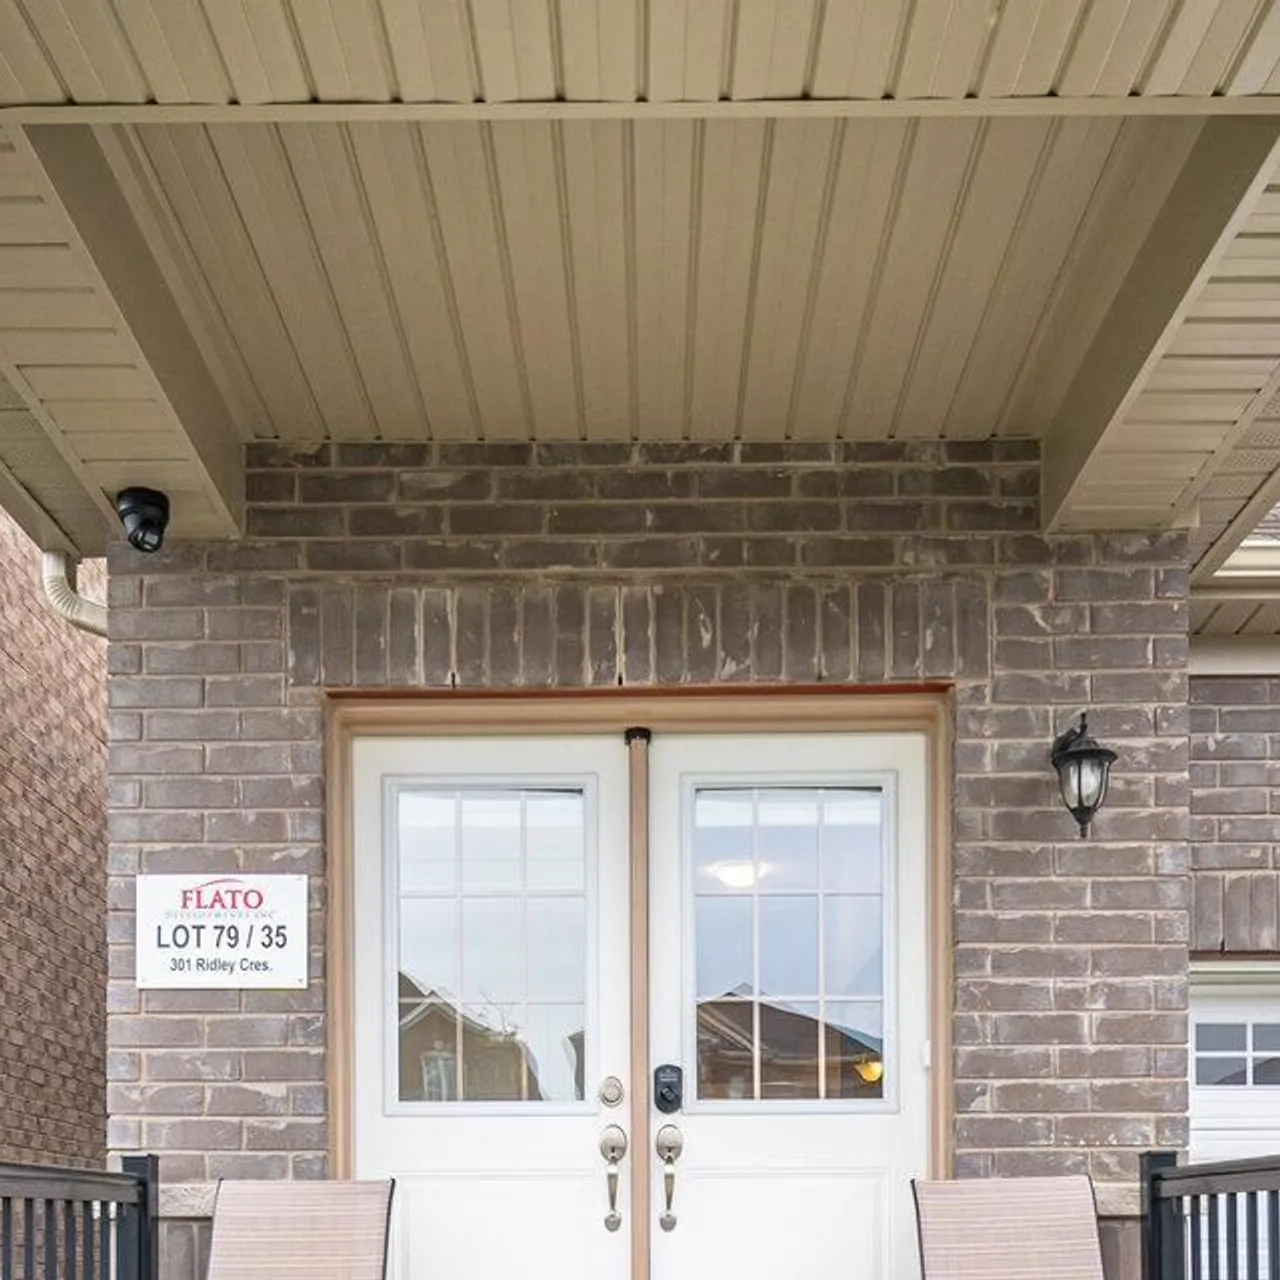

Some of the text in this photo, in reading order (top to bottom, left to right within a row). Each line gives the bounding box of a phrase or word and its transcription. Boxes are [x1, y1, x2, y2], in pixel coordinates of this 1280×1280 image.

[180, 889, 264, 910] FLATO
[157, 925, 287, 948] LOT 79 / 35
[170, 957, 273, 974] 301 Ridley Cres.
